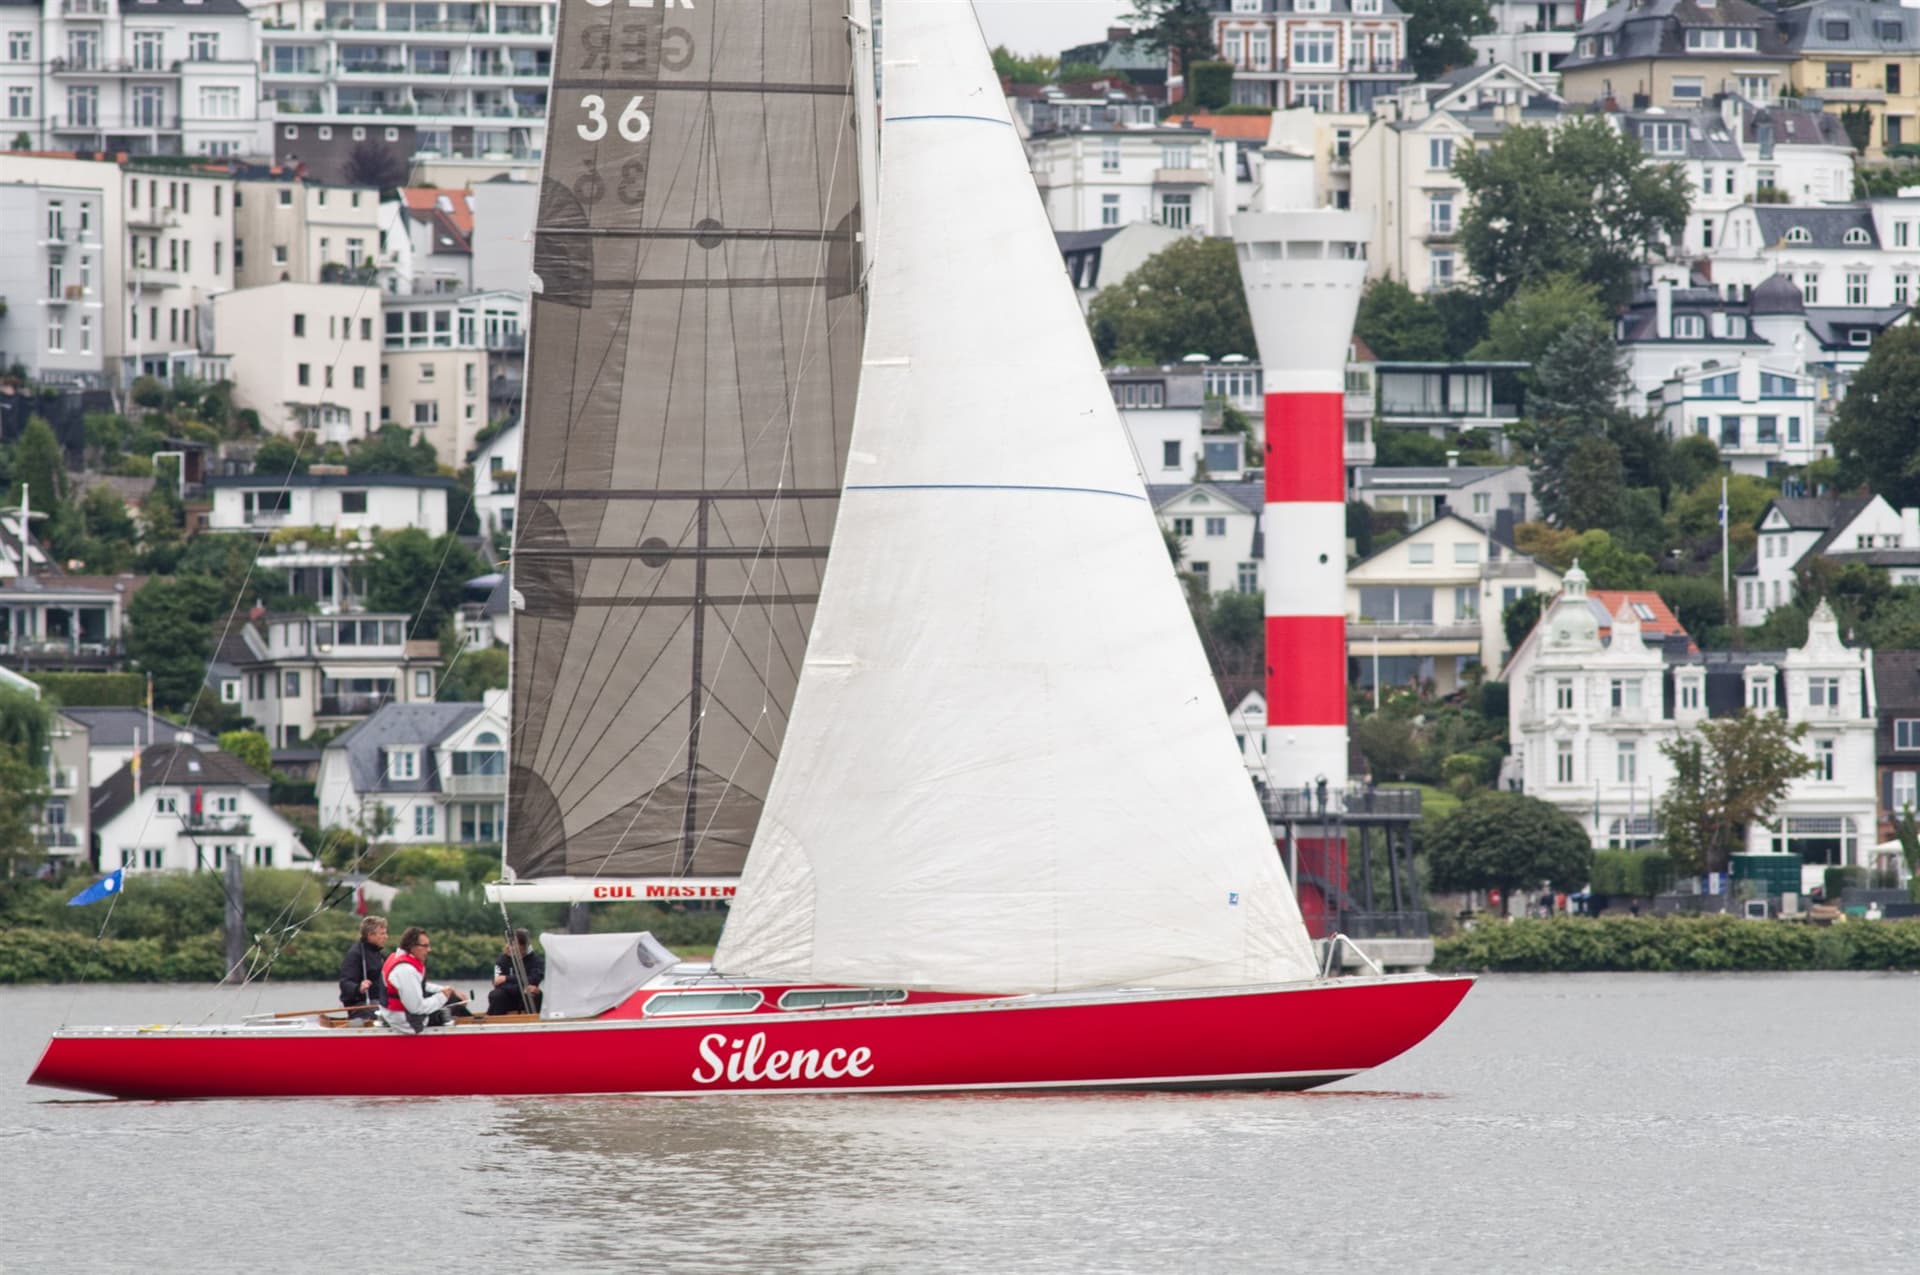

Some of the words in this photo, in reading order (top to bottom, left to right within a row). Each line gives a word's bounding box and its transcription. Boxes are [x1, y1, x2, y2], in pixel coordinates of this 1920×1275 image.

[576, 94, 651, 142] 36
[593, 885, 635, 899] CUL
[645, 885, 737, 897] MASTEN
[691, 1031, 875, 1084] Silence
